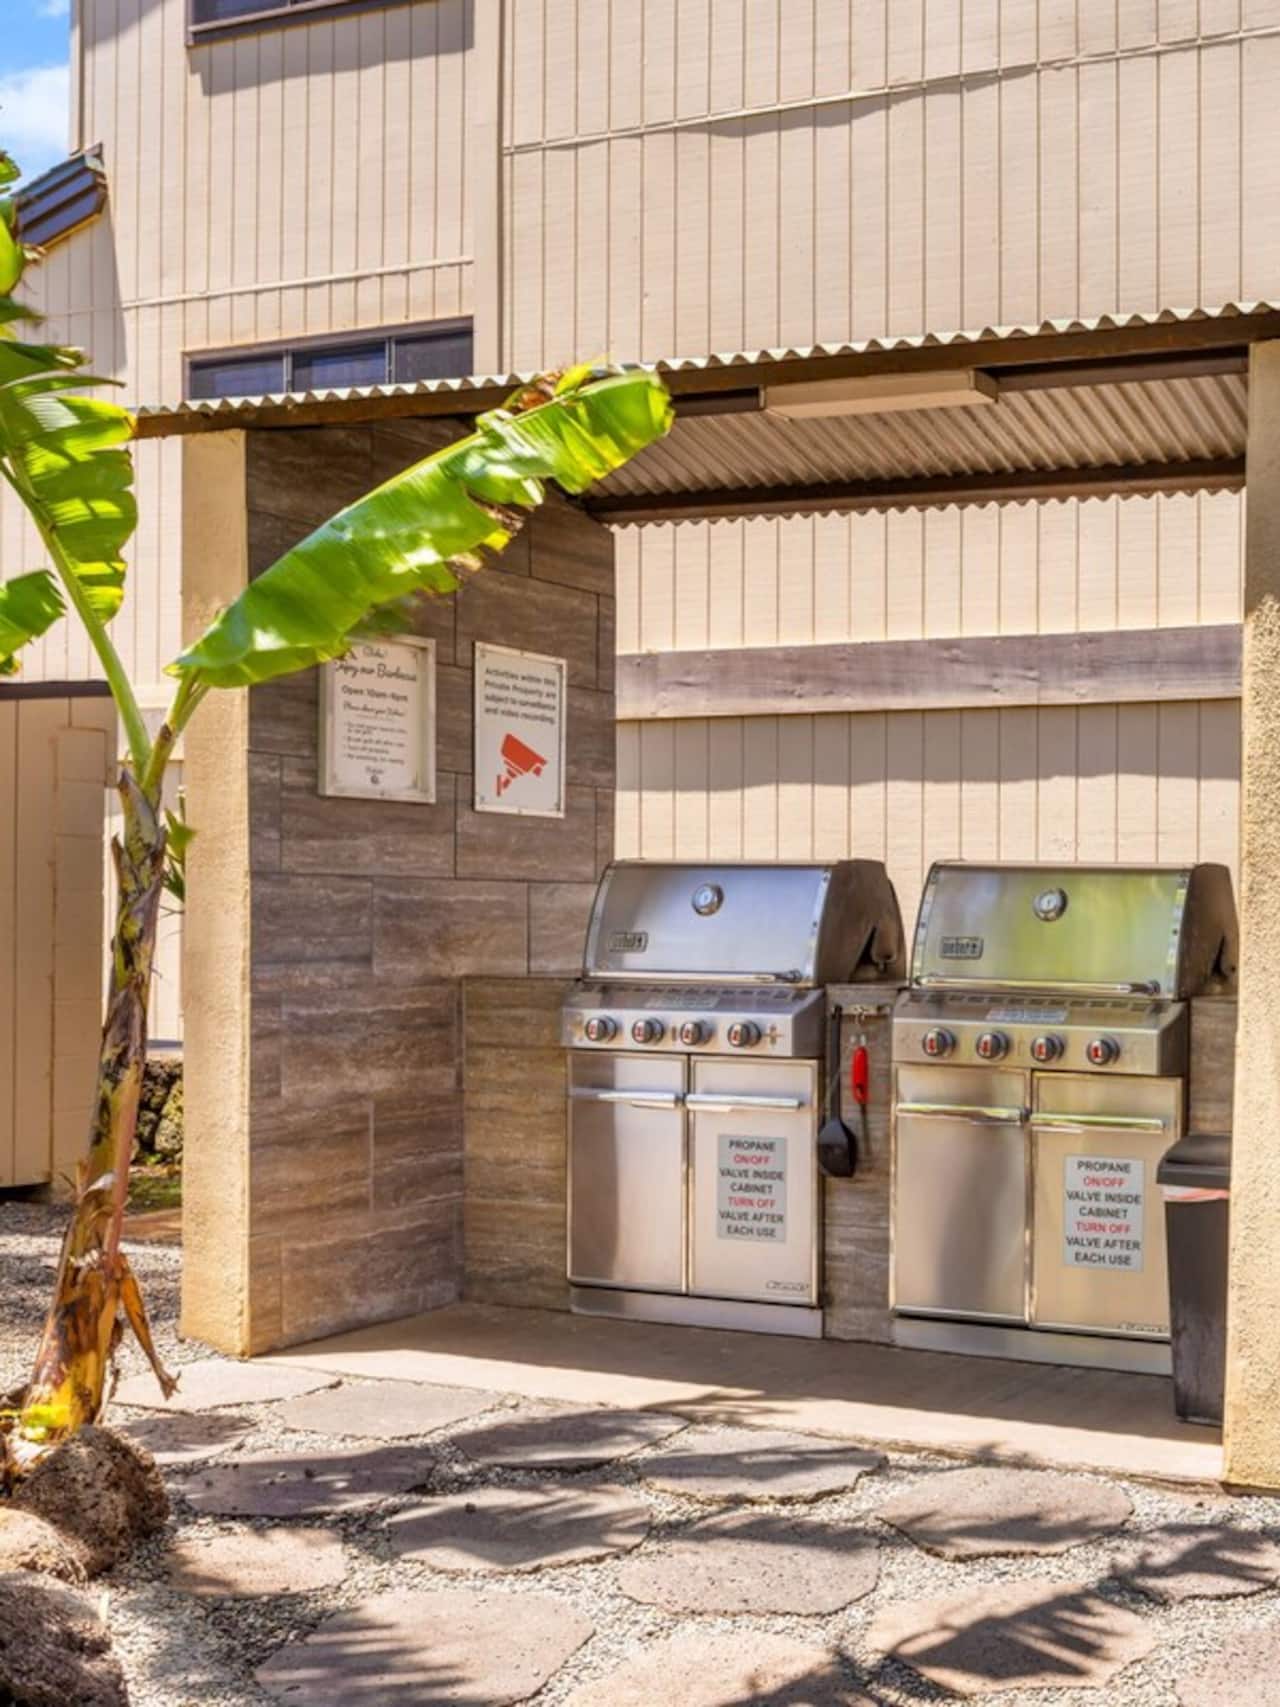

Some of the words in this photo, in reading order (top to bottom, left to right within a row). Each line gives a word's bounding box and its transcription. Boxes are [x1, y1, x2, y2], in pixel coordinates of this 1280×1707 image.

[485, 667, 519, 680] Activities
[521, 674, 542, 684] within
[543, 678, 556, 687] this
[484, 680, 510, 691] Private
[511, 684, 543, 698] Property
[484, 694, 509, 705] subject
[518, 699, 557, 712] surveillance
[484, 706, 498, 715] and
[501, 708, 520, 718] video
[729, 1139, 776, 1152] PROPANE
[734, 1153, 769, 1165] ON/OFF
[1077, 1160, 1131, 1173] PROPANE
[719, 1167, 749, 1179] VALVE
[752, 1169, 785, 1181] INSIDE
[730, 1182, 773, 1194] CABINET
[1083, 1176, 1125, 1187] ON/OFF
[728, 1196, 754, 1207] TURN
[756, 1198, 776, 1209] OFF
[1066, 1190, 1101, 1202] VALVE
[1104, 1192, 1142, 1205] INSIDE
[719, 1209, 749, 1221] VALVE
[752, 1212, 785, 1224] AFTER
[1079, 1207, 1128, 1219] CABINET
[727, 1225, 754, 1235] EACH
[756, 1226, 776, 1238] USE
[1076, 1221, 1106, 1233] TURN
[1109, 1223, 1131, 1234] OFF
[1066, 1236, 1101, 1248] VALVE
[1104, 1239, 1141, 1251] AFTER
[1074, 1252, 1105, 1264] EACH
[1108, 1254, 1132, 1266] USE
